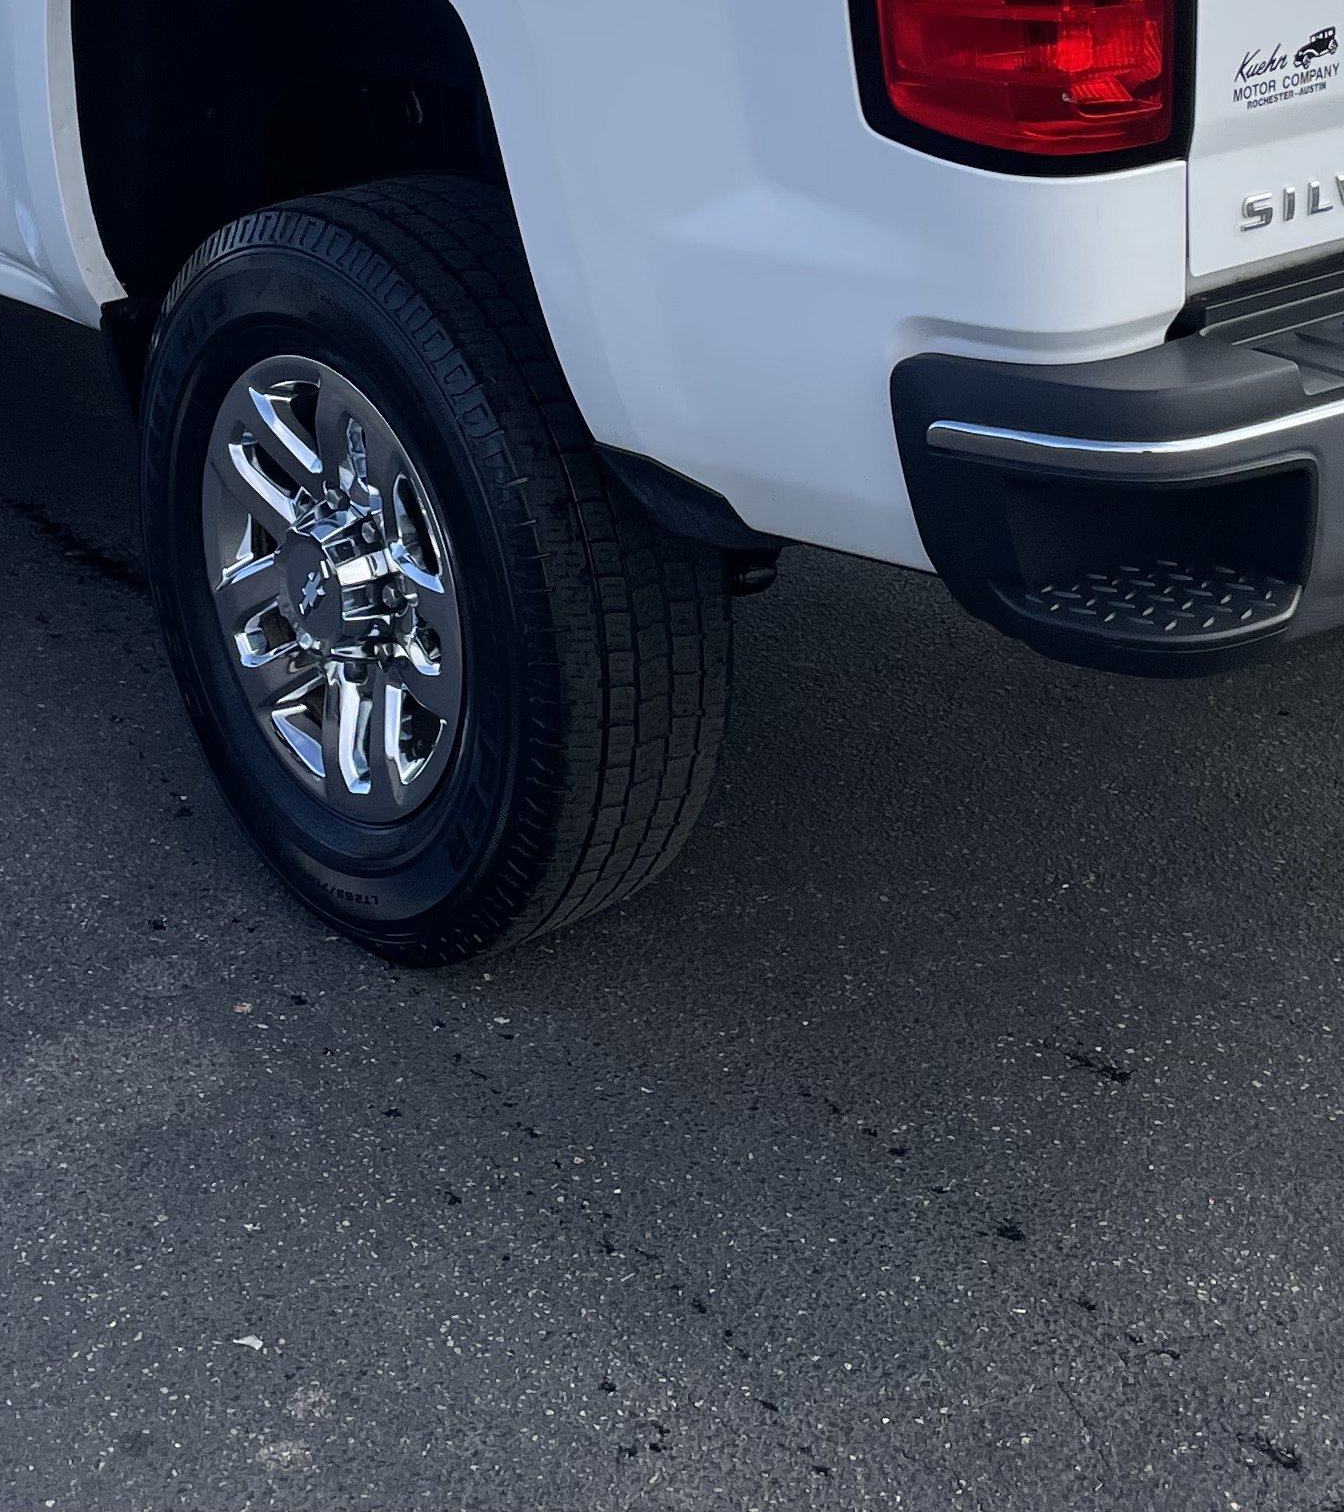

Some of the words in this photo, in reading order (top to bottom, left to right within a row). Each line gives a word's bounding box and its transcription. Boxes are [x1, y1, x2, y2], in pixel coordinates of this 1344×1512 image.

[1233, 79, 1277, 103] MOTOR
[1282, 62, 1341, 89] COMPANY
[1234, 43, 1288, 84] Kuehn
